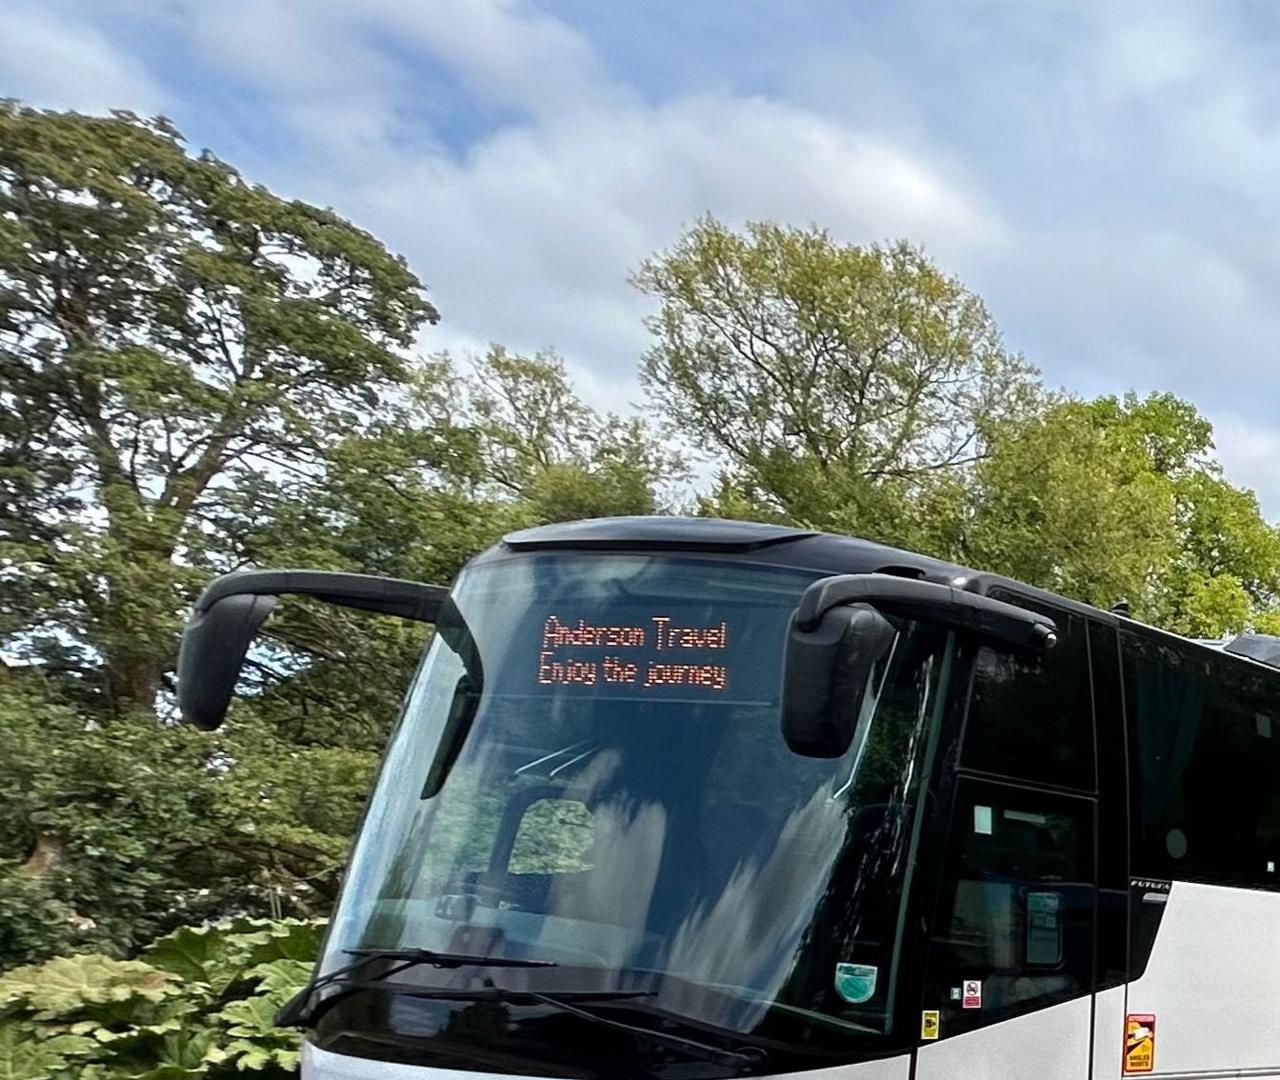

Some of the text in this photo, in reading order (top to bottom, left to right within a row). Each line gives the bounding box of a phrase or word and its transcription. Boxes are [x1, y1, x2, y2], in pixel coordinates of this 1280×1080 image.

[542, 615, 727, 650] Anderson Travel
[538, 651, 726, 690] Enjoy the journey
